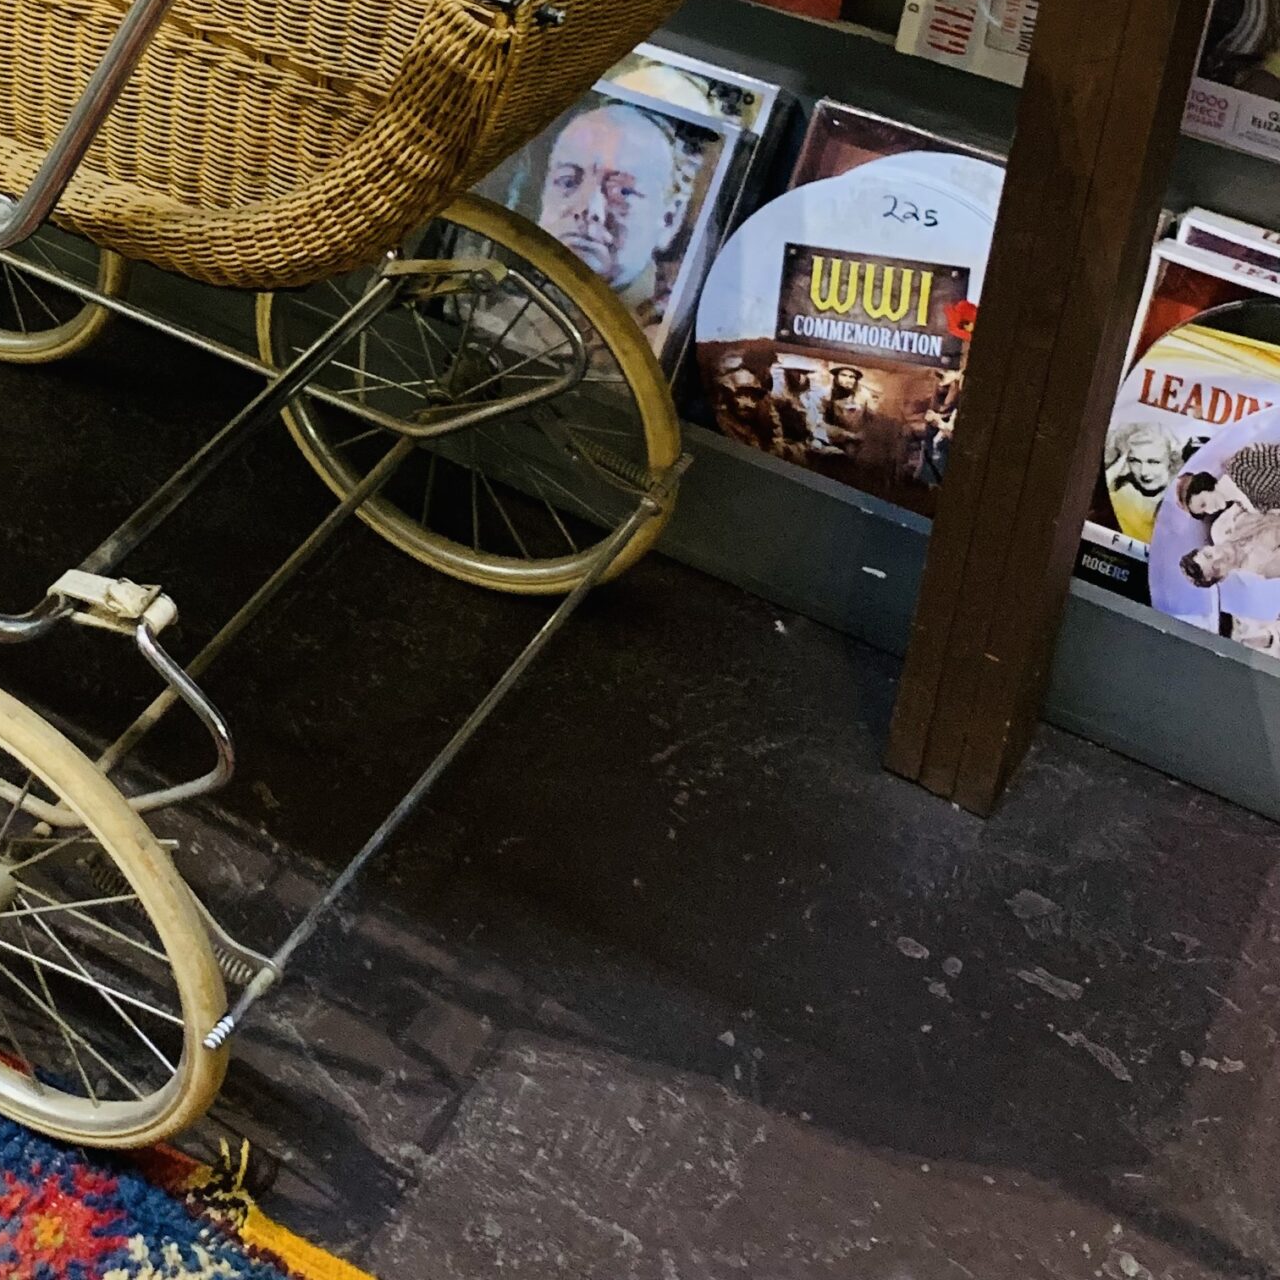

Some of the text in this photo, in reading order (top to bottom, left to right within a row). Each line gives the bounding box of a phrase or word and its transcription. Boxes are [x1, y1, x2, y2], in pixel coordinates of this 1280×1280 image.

[1191, 89, 1229, 111] 1000
[882, 195, 939, 227] 225
[810, 255, 933, 326] WWI
[793, 315, 943, 357] COMMEMORATION
[1138, 368, 1273, 425] LEADI
[1082, 554, 1131, 582] ROGERS
